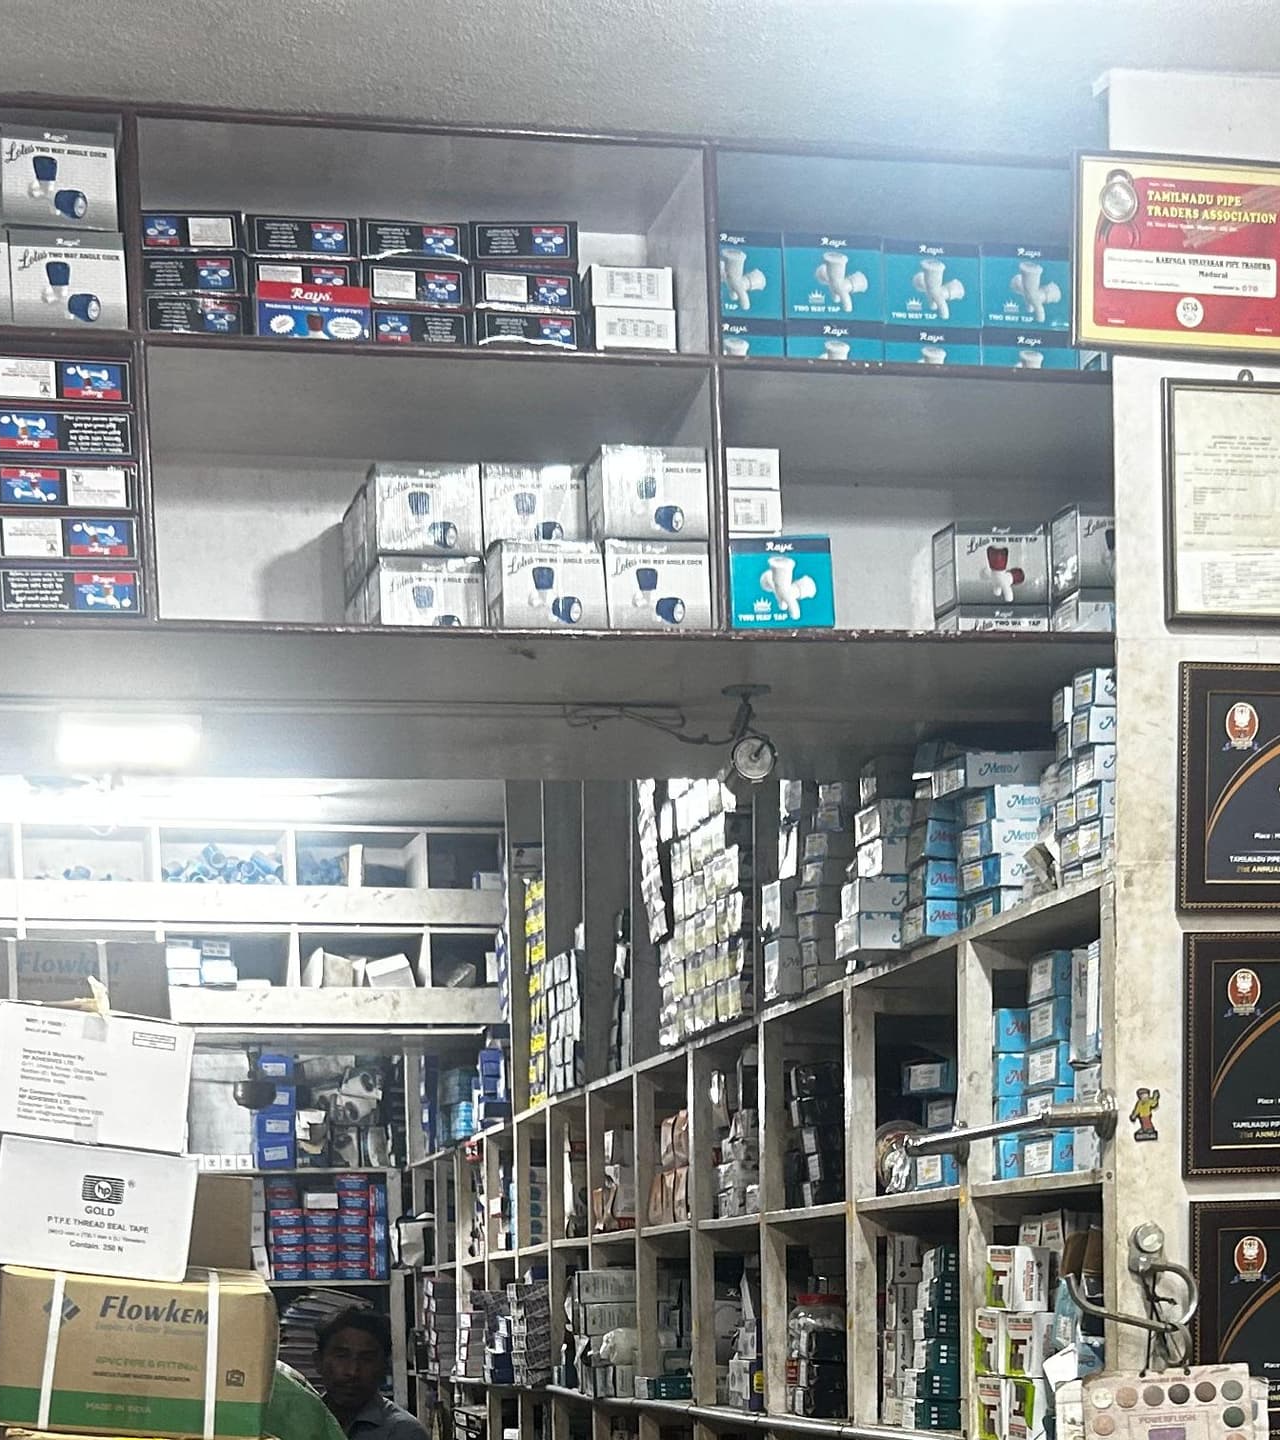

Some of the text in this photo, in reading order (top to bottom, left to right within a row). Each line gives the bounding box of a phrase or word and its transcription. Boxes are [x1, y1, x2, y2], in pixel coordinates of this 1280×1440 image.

[1147, 190, 1242, 207] TAMILNADU PIPE
[1147, 206, 1277, 224] TRADERS ASSOCIATION
[290, 287, 333, 302] Rays
[97, 1184, 111, 1197] hp
[84, 1205, 115, 1217] GOLD
[73, 1219, 105, 1229] THREAD
[107, 1222, 127, 1231] SEAL
[129, 1224, 149, 1233] TAPE
